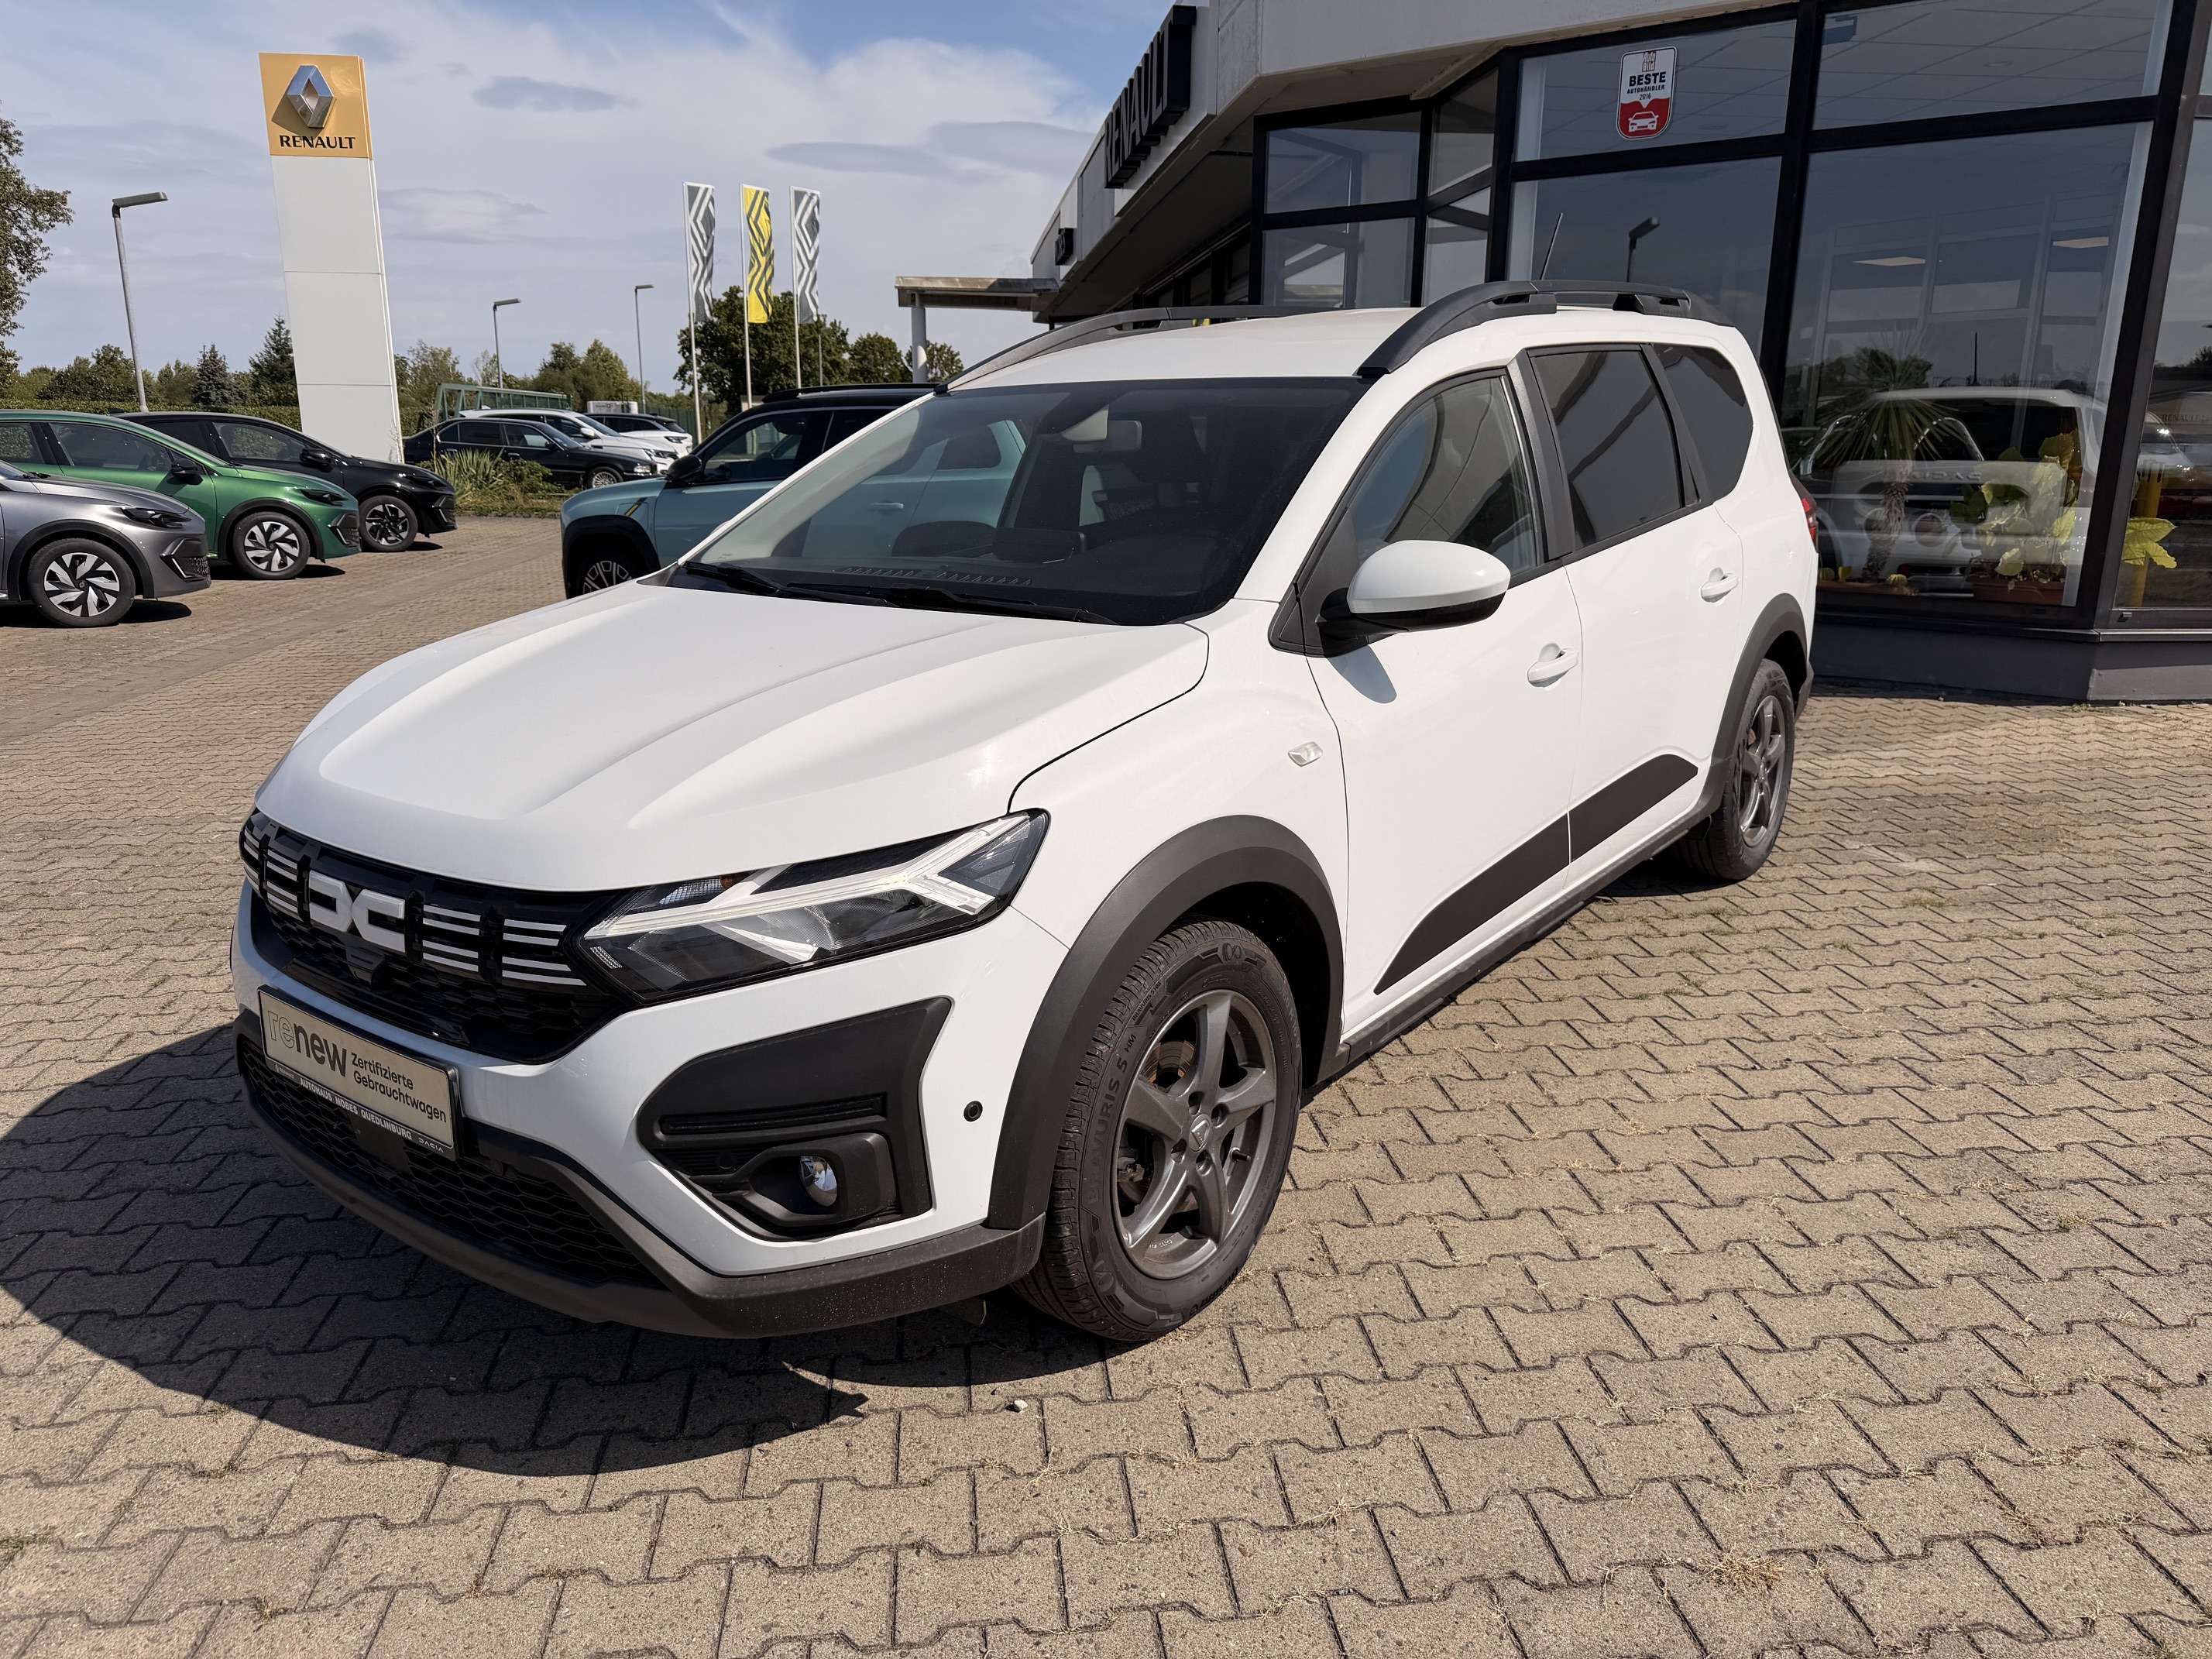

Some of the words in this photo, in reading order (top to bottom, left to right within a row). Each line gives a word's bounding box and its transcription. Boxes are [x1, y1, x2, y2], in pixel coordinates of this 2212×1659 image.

[1104, 5, 1197, 188] RENAULT
[1626, 84, 1664, 94] AUTOHÄNDLER
[1629, 71, 1666, 87] BESTE
[279, 135, 356, 149] RENAULT
[267, 1010, 347, 1077] renew
[350, 1053, 414, 1091] Zertifizierte
[299, 1077, 333, 1103] AUTOHAUS
[360, 1108, 413, 1141] QUEDLINBURG
[353, 1070, 447, 1123] Gebrauchtwagen
